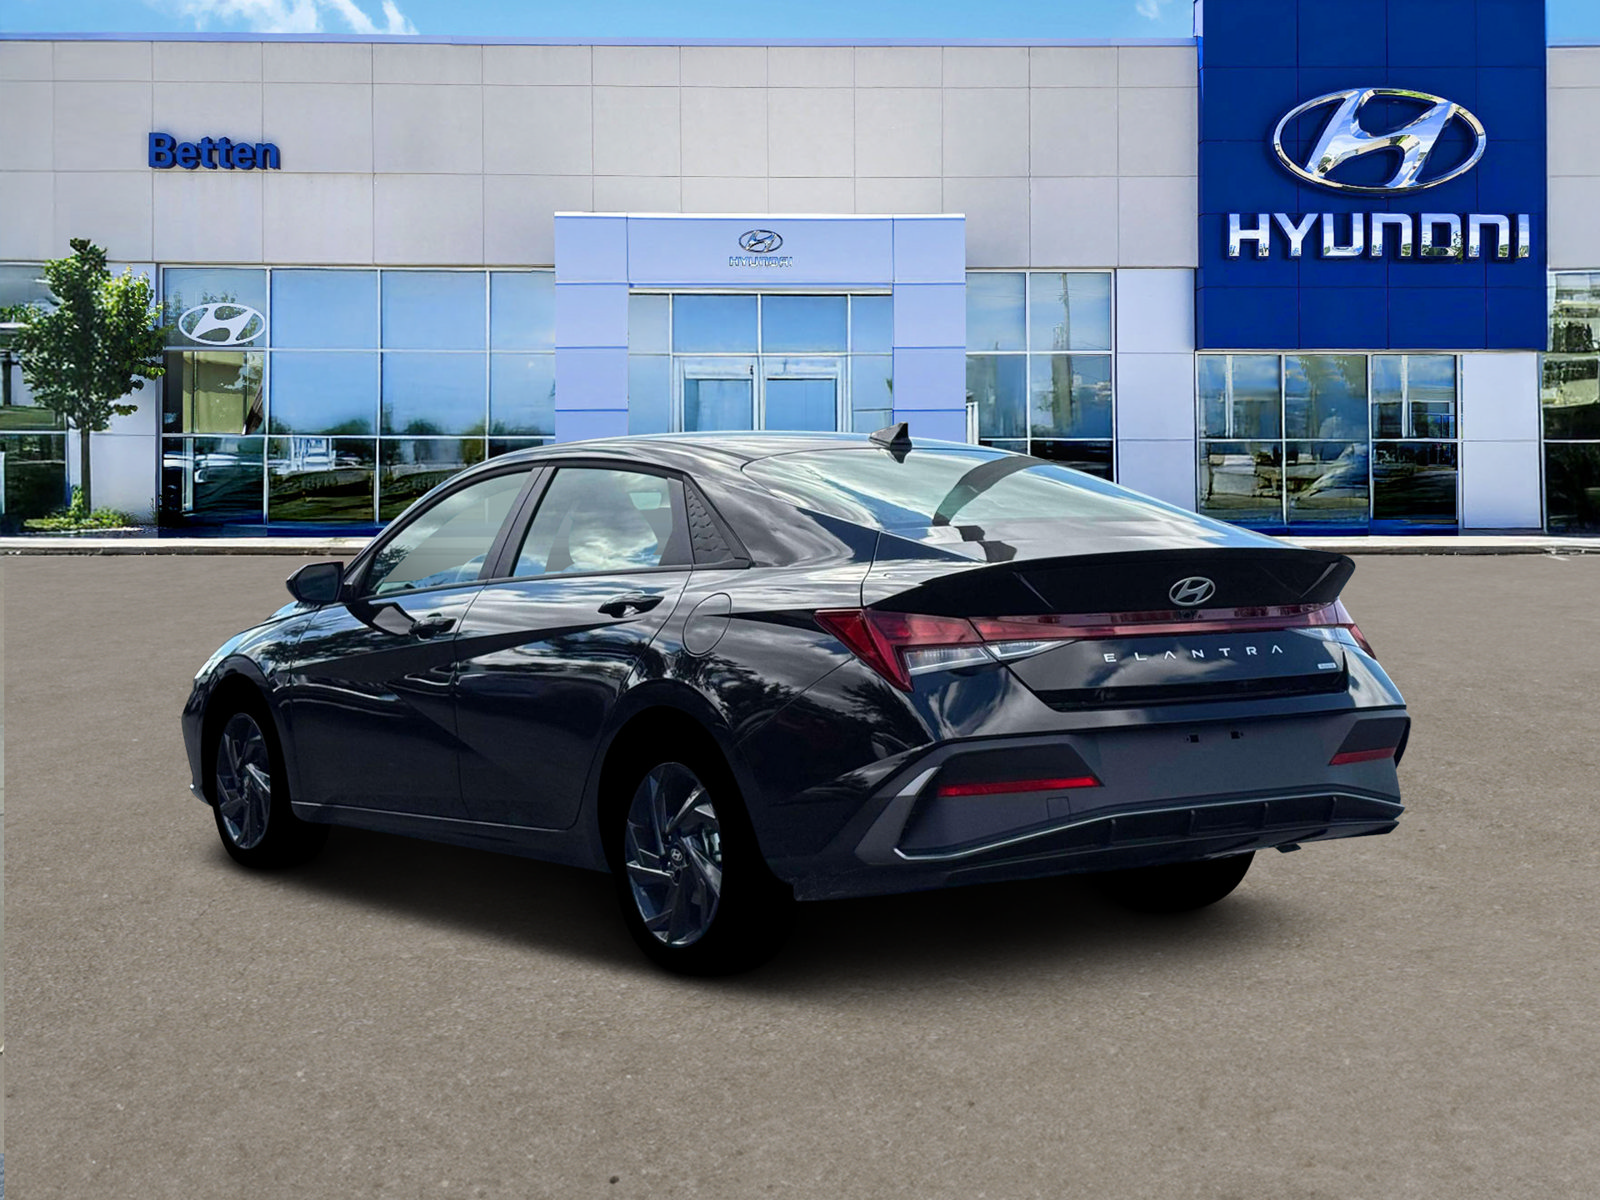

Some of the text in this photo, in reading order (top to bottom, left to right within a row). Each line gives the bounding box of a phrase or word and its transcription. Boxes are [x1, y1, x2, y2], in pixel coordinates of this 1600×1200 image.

[149, 132, 281, 170] Betten
[1227, 213, 1530, 258] HYUNDAI
[729, 256, 793, 267] HYUNDAI
[1103, 644, 1283, 663] ELANTRA
